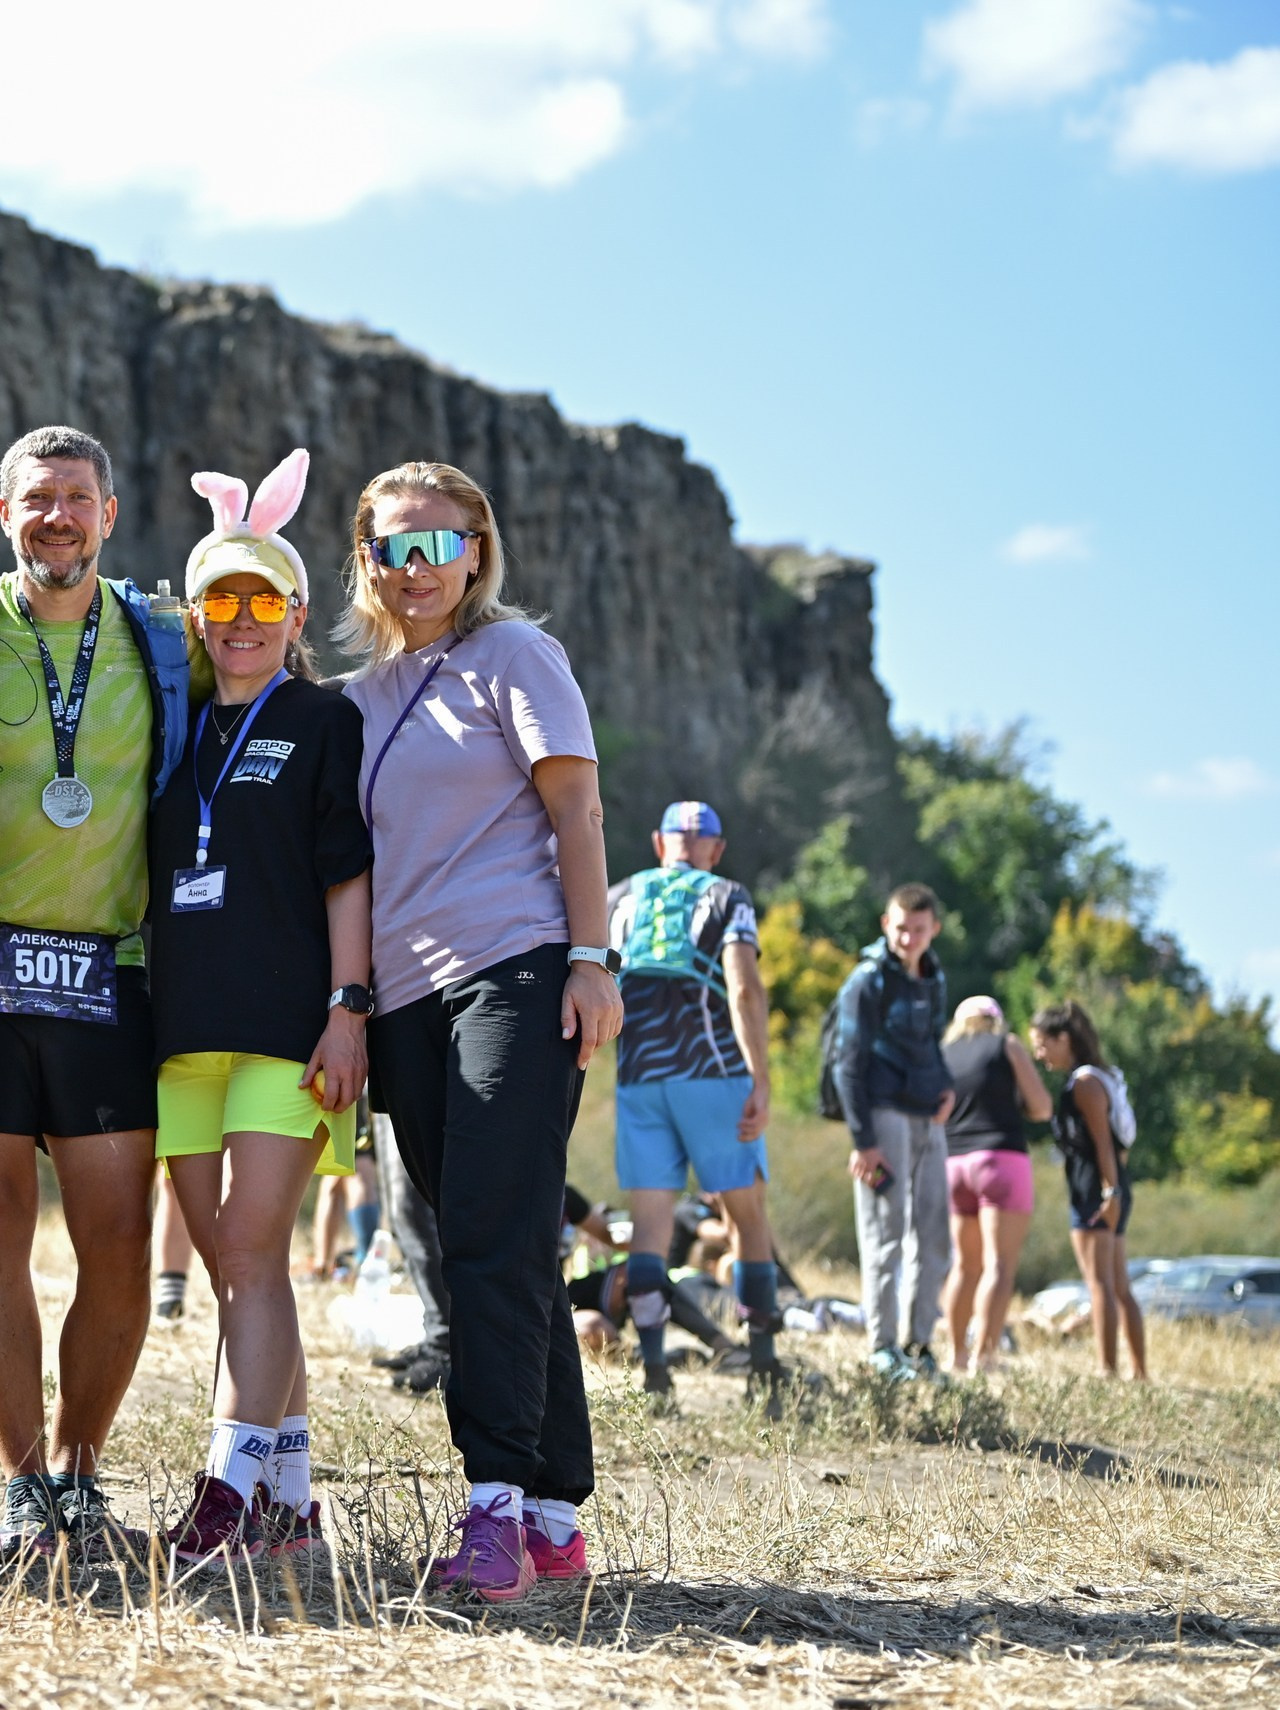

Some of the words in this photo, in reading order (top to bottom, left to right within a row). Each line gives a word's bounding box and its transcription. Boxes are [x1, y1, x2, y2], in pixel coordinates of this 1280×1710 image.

[249, 742, 291, 751] ЯДРО
[253, 777, 273, 785] TRAIL
[54, 785, 77, 797] DST
[188, 888, 208, 897] Анна
[9, 933, 98, 954] АЛЕКСАНДР
[15, 949, 92, 988] 5017
